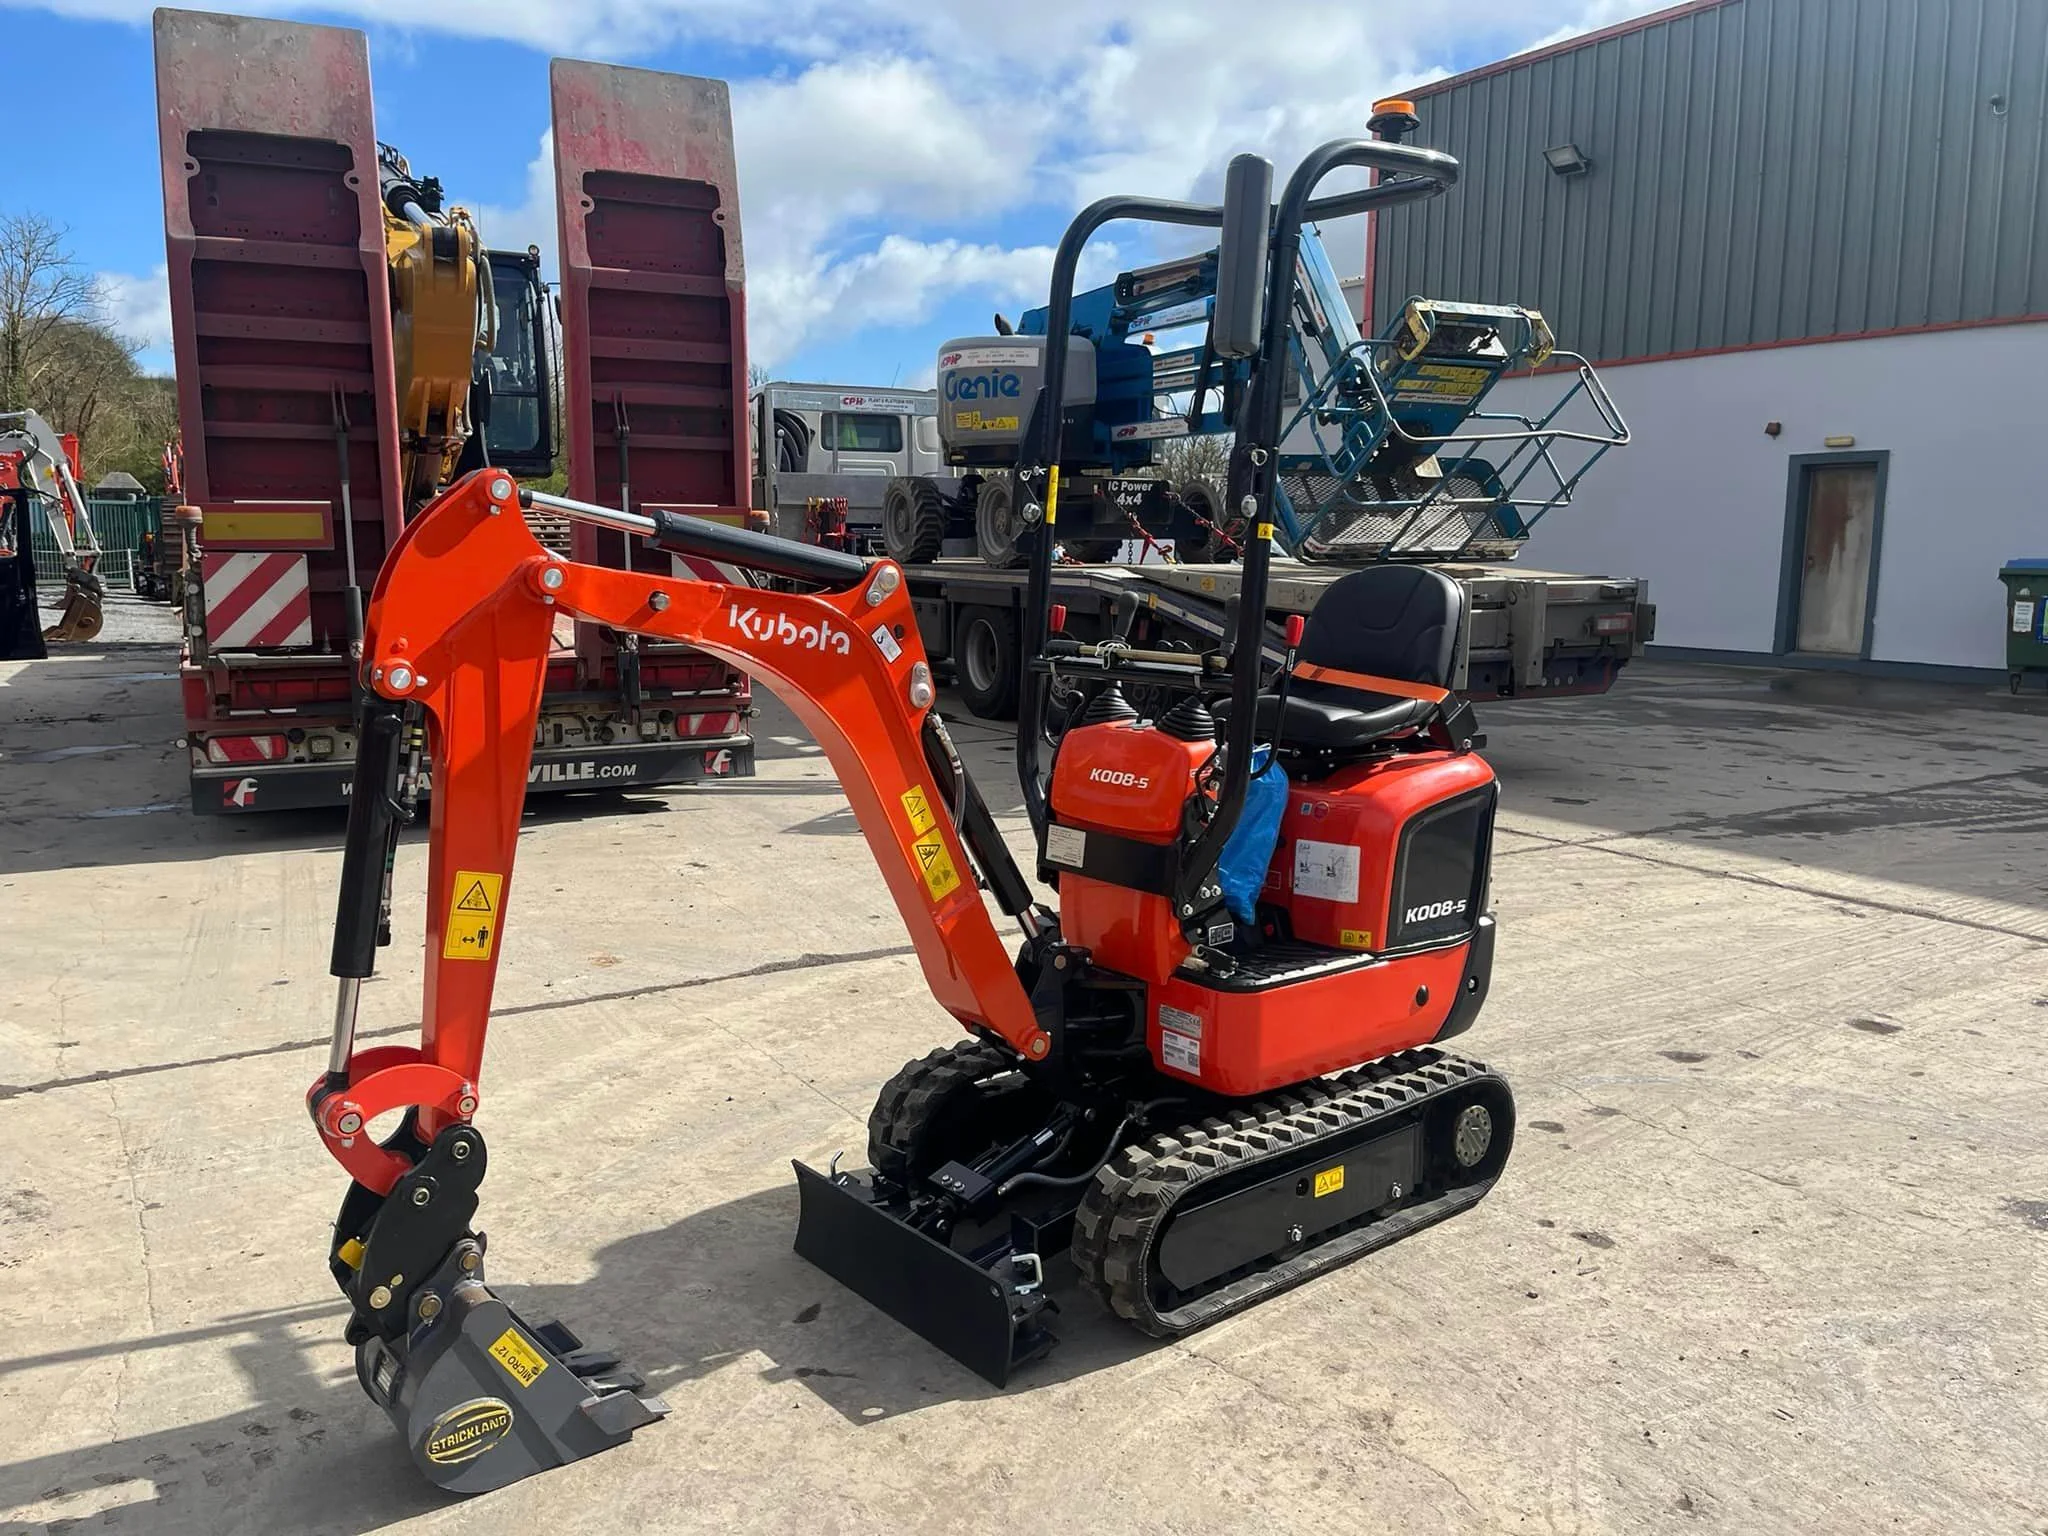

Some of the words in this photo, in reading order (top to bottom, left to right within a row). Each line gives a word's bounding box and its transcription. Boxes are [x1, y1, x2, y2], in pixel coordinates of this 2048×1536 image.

[945, 368, 1021, 401] Genie
[843, 397, 864, 406] CPH
[1108, 481, 1119, 491] IC
[1121, 481, 1153, 492] Power
[1116, 492, 1142, 505] 4x4
[729, 604, 850, 655] Kubota
[1089, 767, 1150, 789] K008-5
[1404, 899, 1467, 924] K008-5
[507, 1355, 534, 1382] MICRO
[431, 1415, 507, 1453] STRICKLAND
